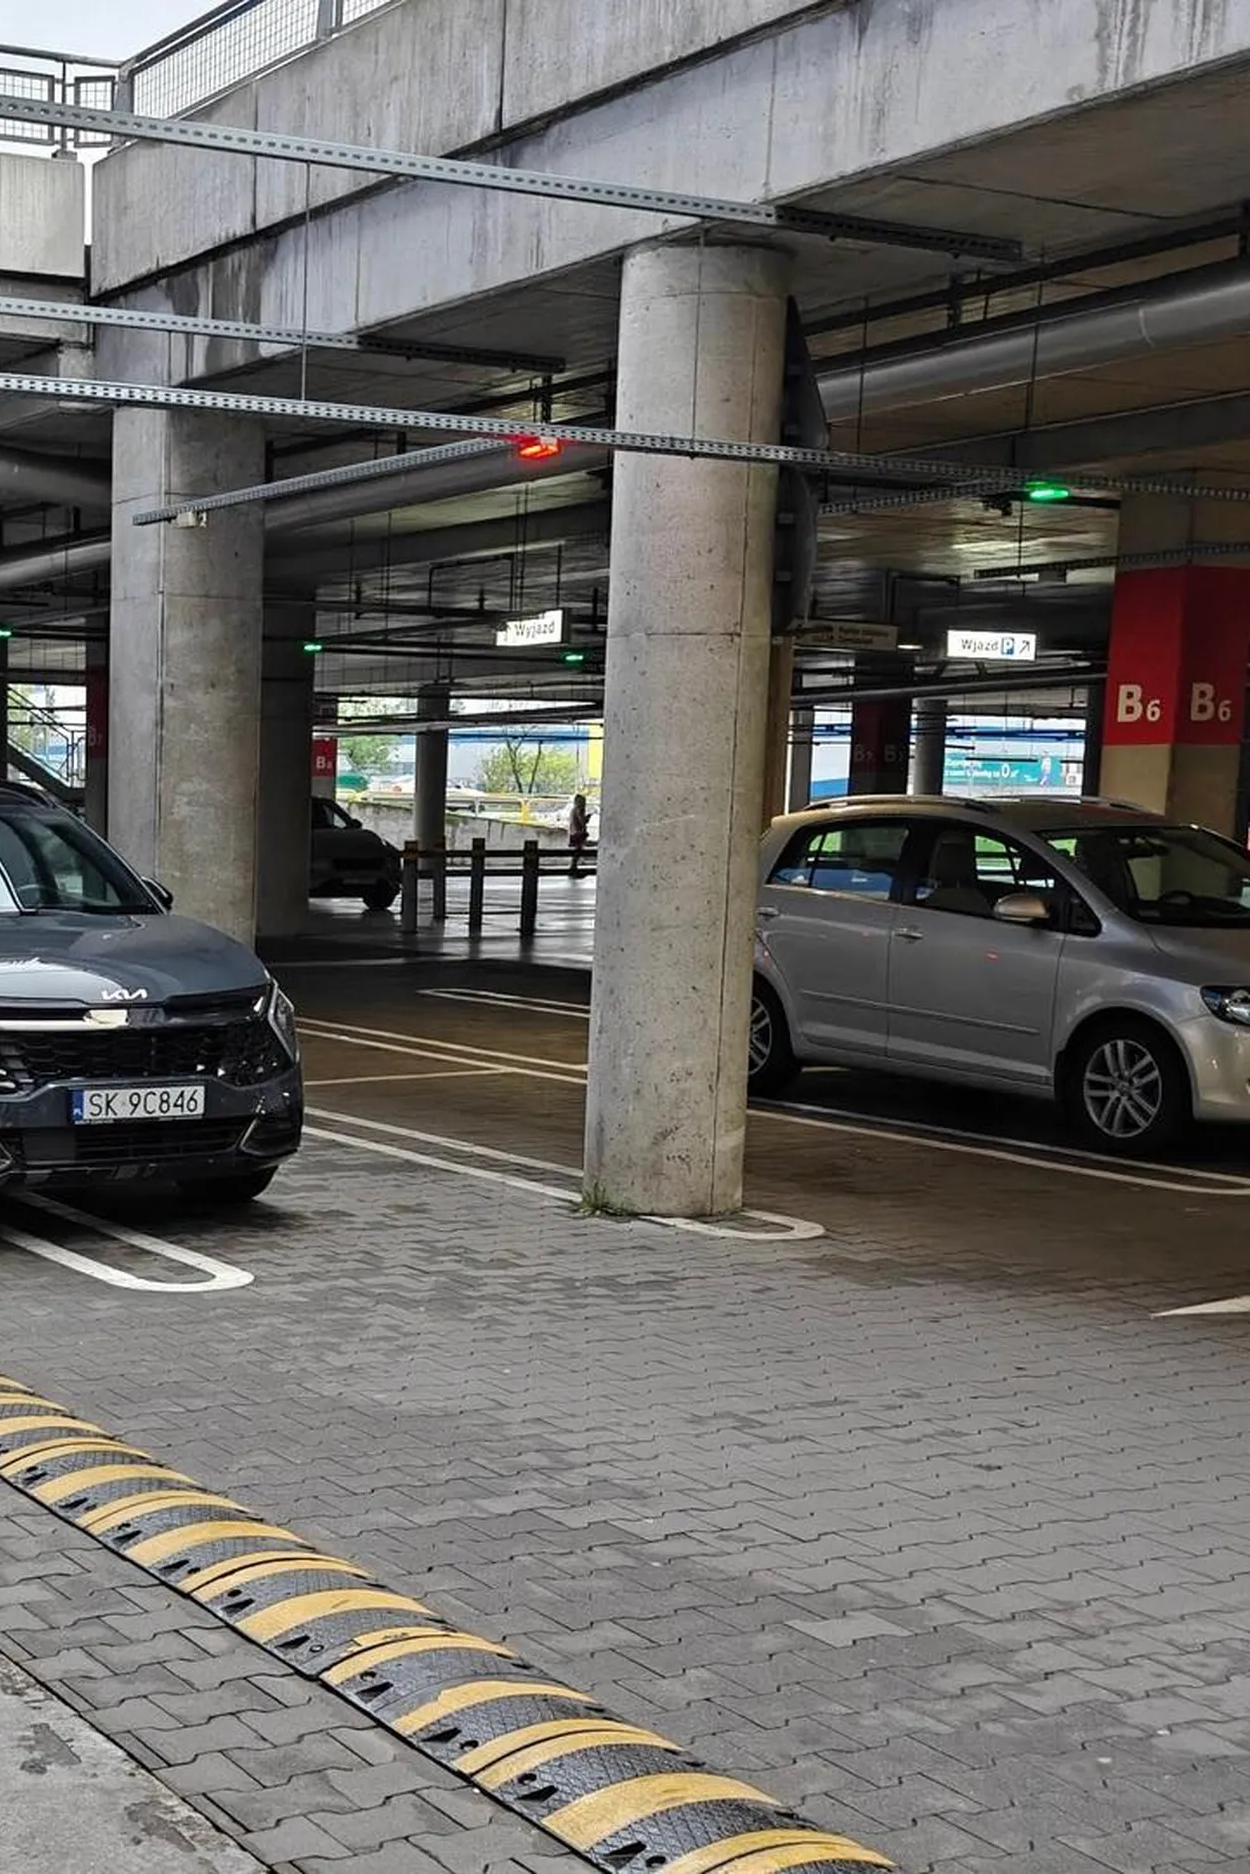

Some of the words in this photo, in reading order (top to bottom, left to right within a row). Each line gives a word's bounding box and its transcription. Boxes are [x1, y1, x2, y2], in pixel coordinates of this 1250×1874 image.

[514, 621, 555, 639] Wyjazd
[961, 638, 999, 653] Wjazd
[1117, 684, 1161, 722] B6
[1190, 682, 1231, 722] B6
[101, 988, 148, 1000] KIA
